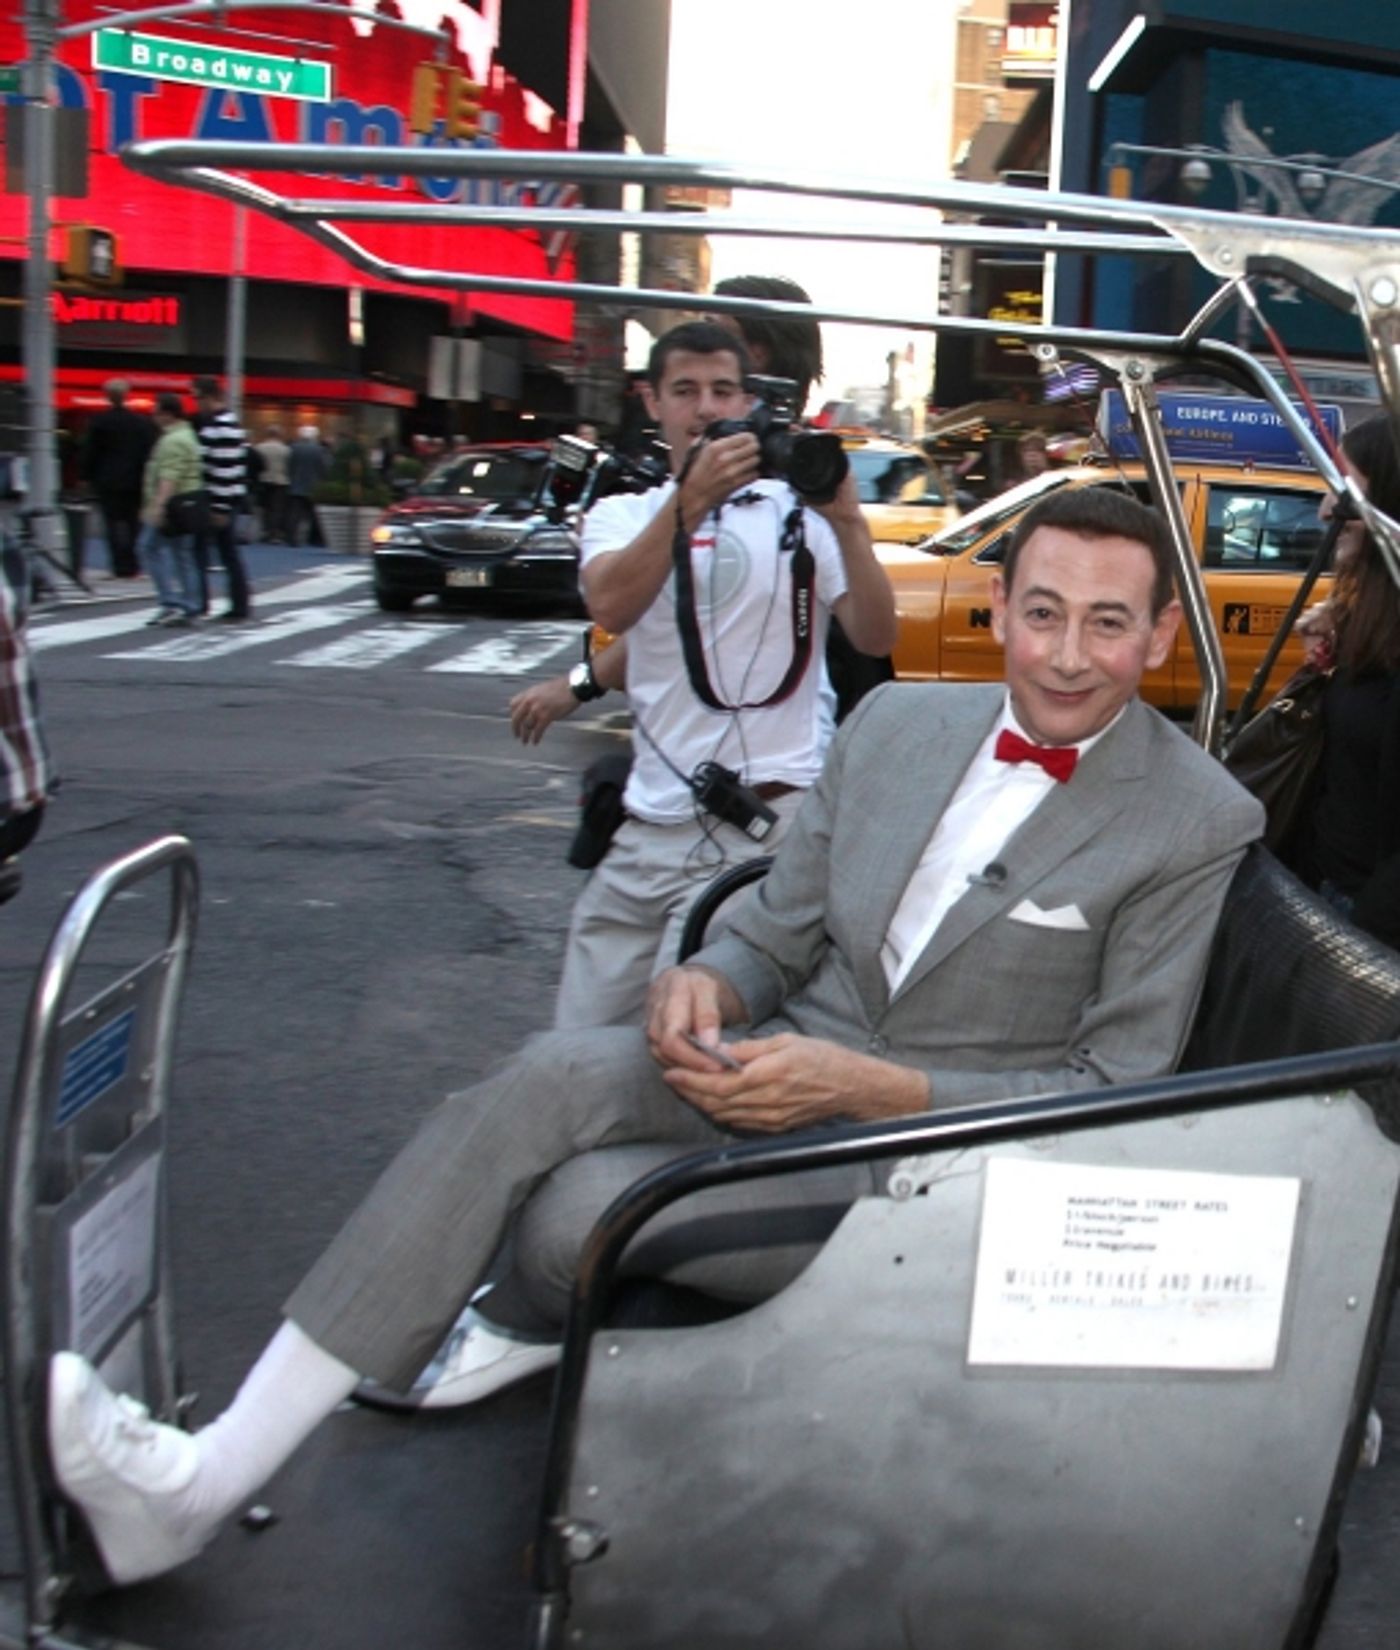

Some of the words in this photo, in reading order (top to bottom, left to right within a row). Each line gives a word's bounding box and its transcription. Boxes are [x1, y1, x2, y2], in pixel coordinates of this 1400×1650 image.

[131, 43, 293, 93] Broadway
[1231, 410, 1258, 425] AND
[797, 588, 808, 638] Canon
[1004, 1267, 1073, 1288] MILLER
[1085, 1269, 1148, 1291] TRIKES
[1158, 1273, 1191, 1292] AND
